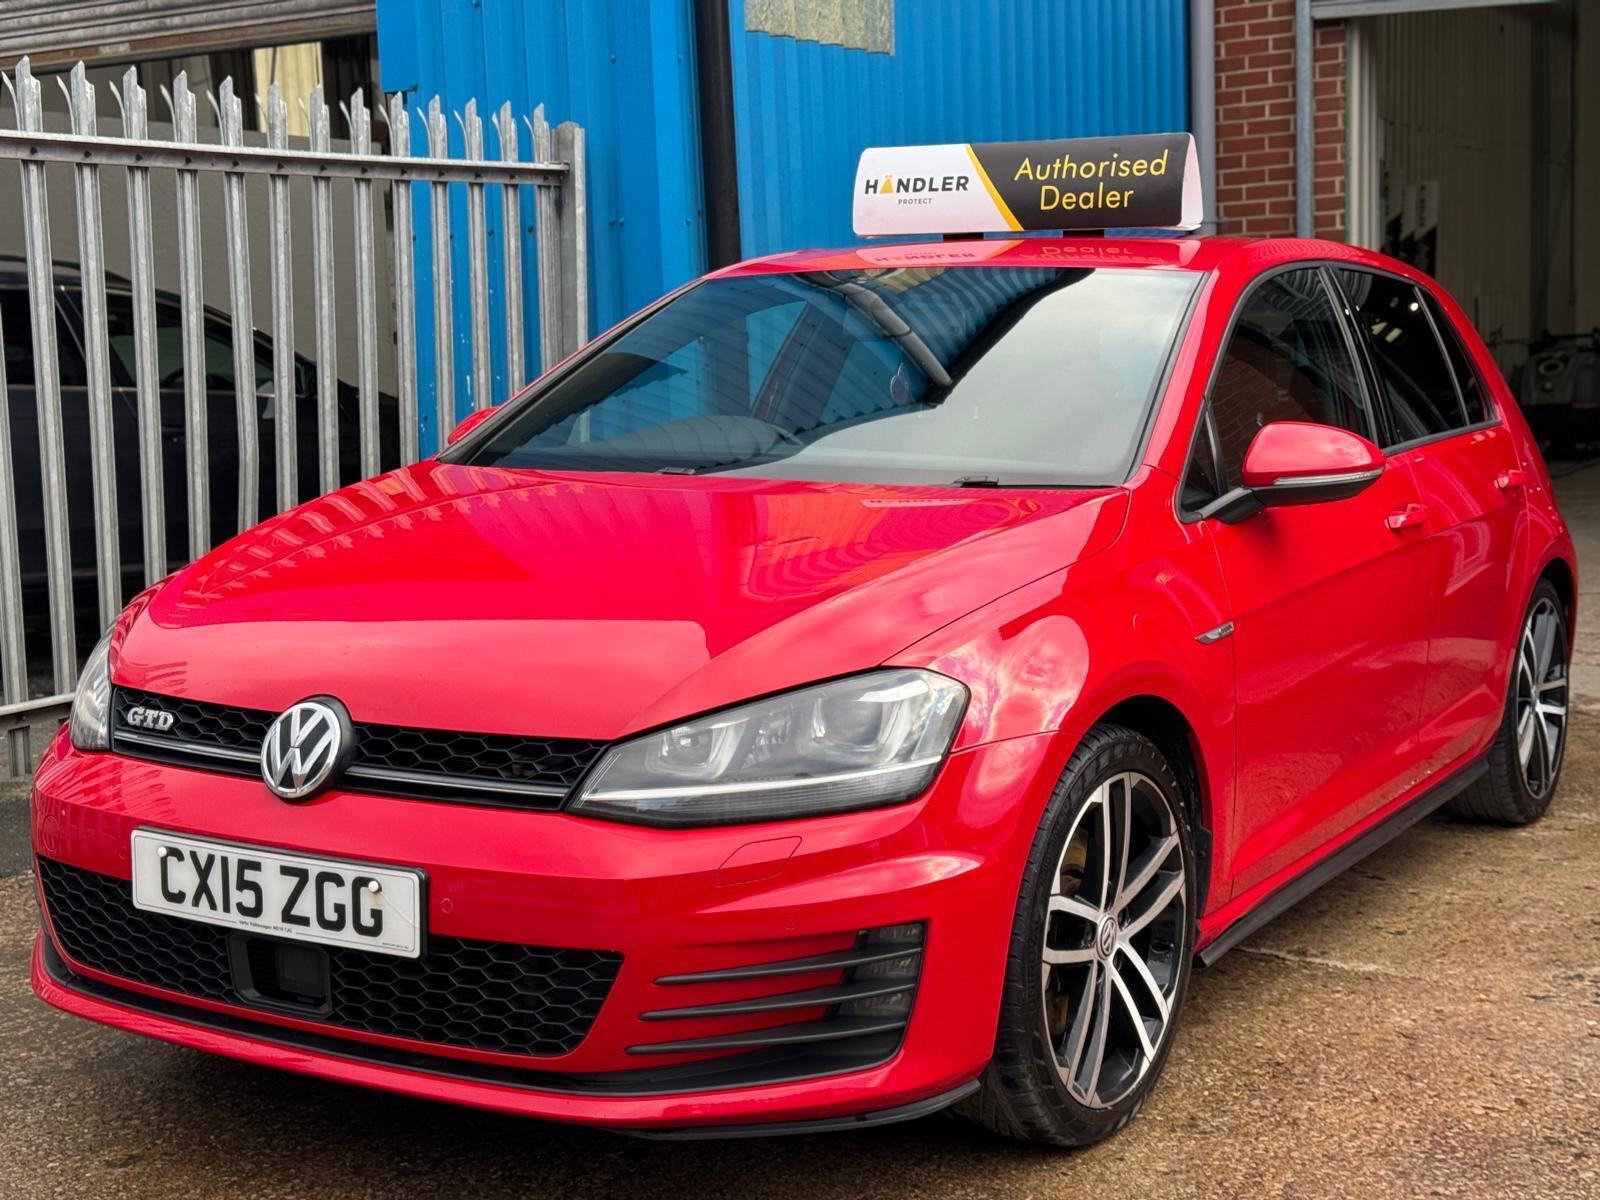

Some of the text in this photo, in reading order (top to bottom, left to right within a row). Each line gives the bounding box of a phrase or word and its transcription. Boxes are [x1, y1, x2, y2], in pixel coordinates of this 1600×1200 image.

[1014, 148, 1169, 181] Authorised
[898, 197, 933, 205] PROTECT
[1040, 182, 1134, 211] Dealer
[127, 706, 174, 732] GTD
[160, 846, 384, 938] CX15 ZGG
